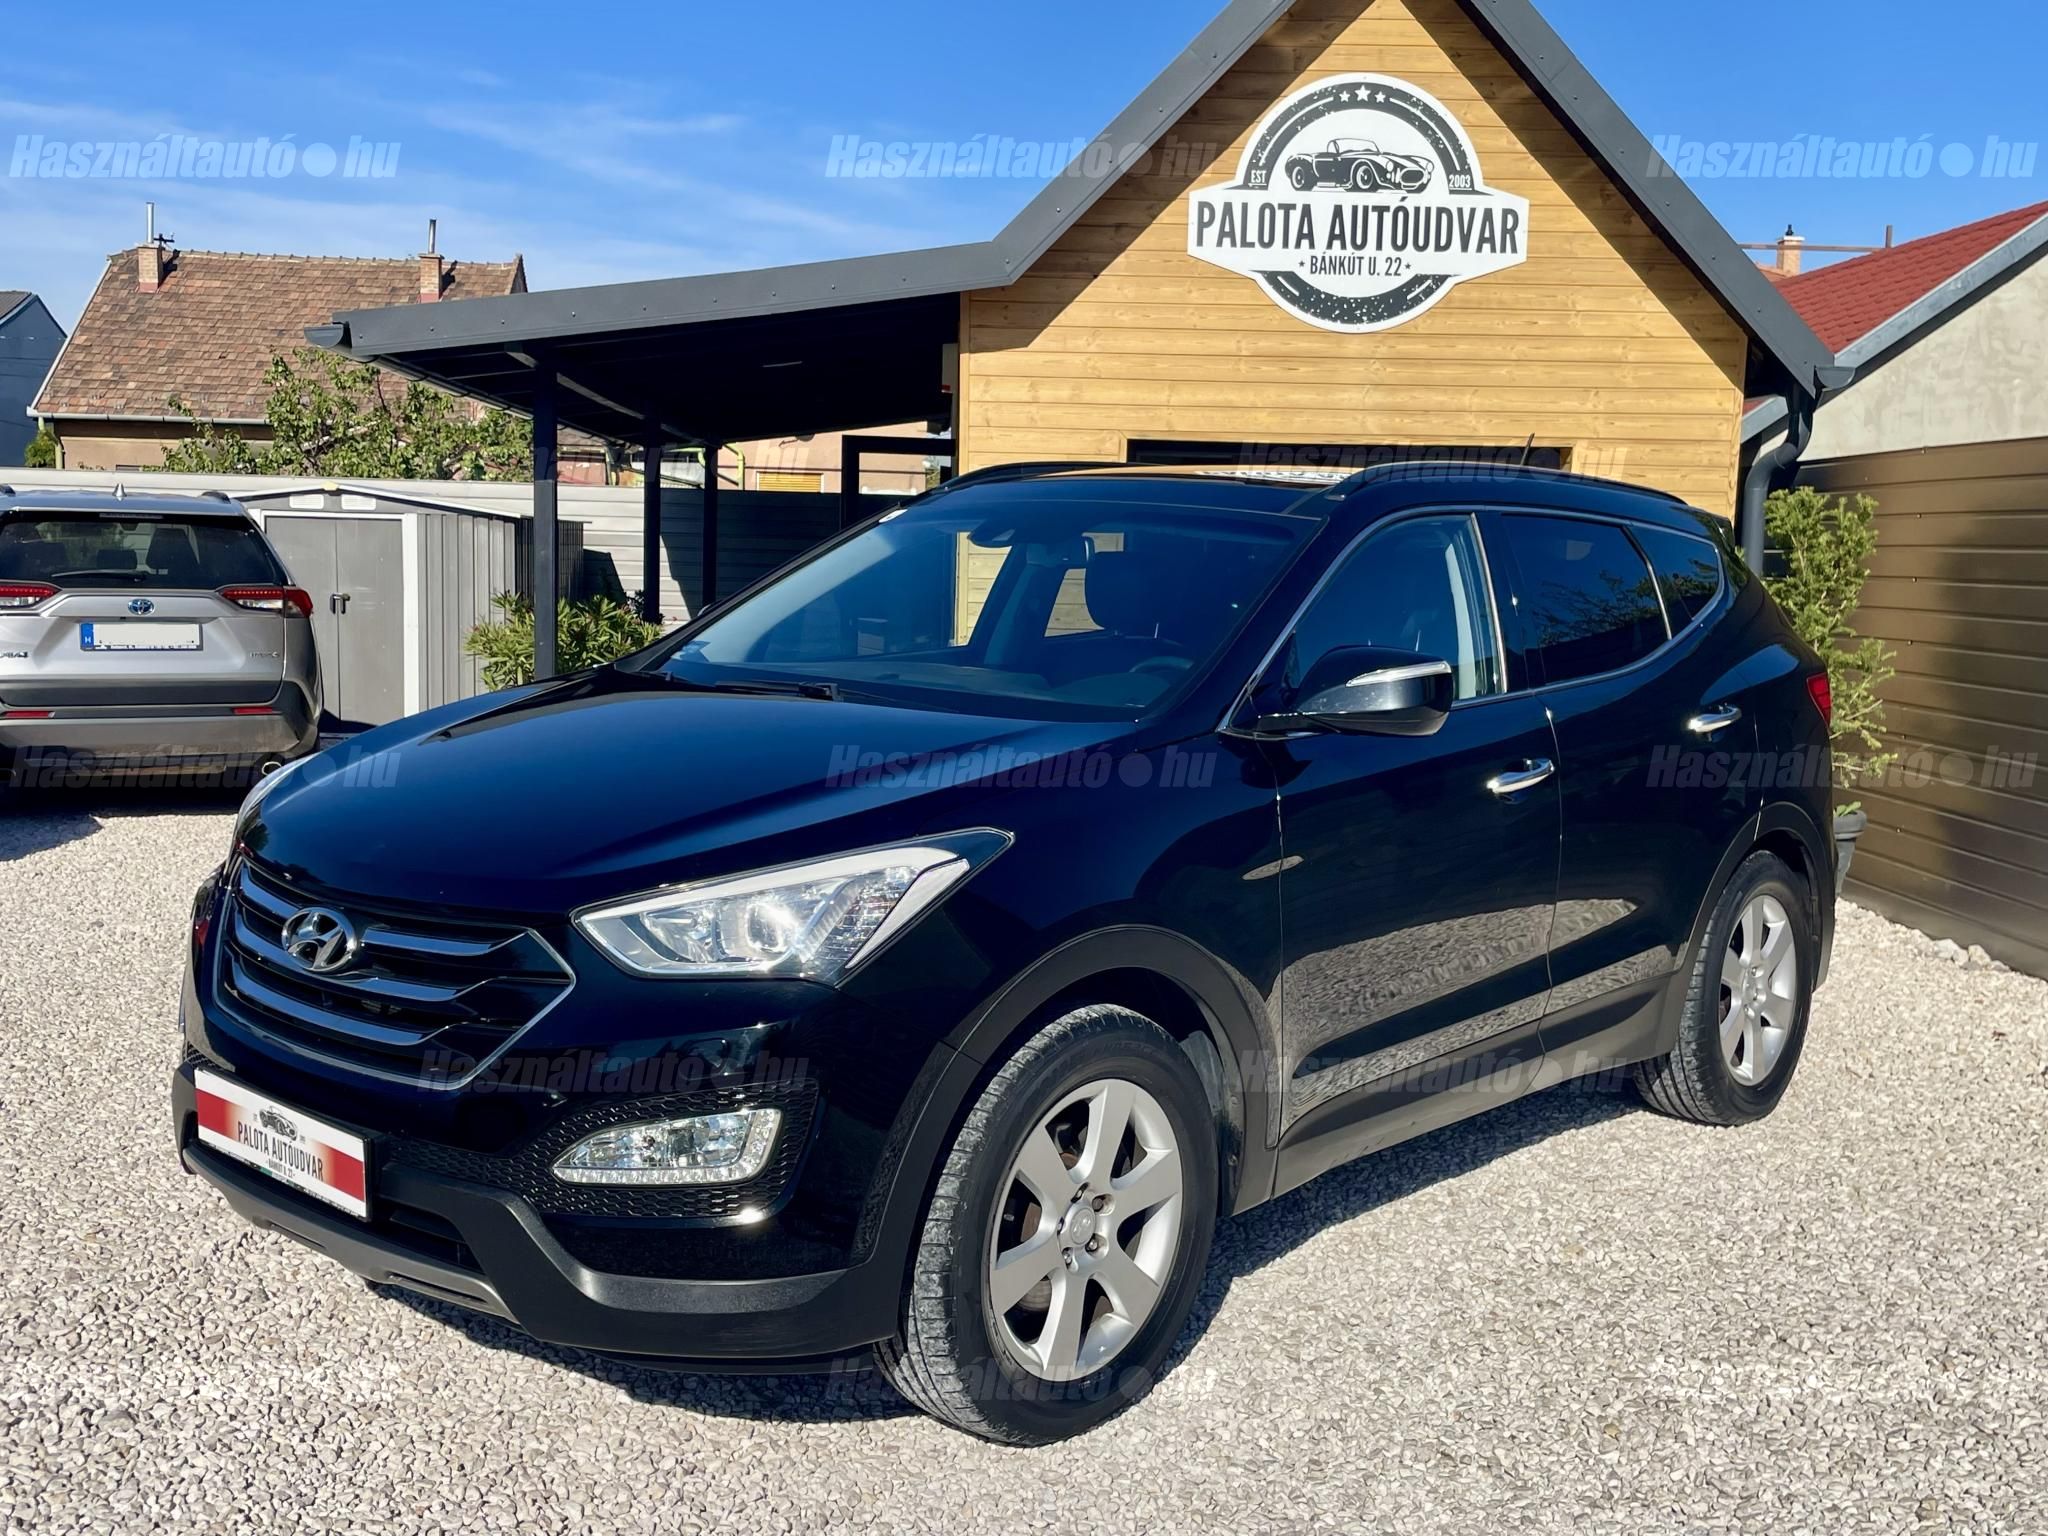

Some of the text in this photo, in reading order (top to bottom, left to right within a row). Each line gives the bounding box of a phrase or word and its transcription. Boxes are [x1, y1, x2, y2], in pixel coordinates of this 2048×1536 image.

[1250, 169, 1267, 184] EST
[1448, 174, 1471, 189] 2003
[1196, 195, 1520, 255] PALOTA AUTÓUDVAR
[1309, 251, 1402, 277] BÁNKÚT U. 22
[237, 1120, 270, 1156] PALOTA
[272, 1136, 325, 1182] AUTÓUDVAR
